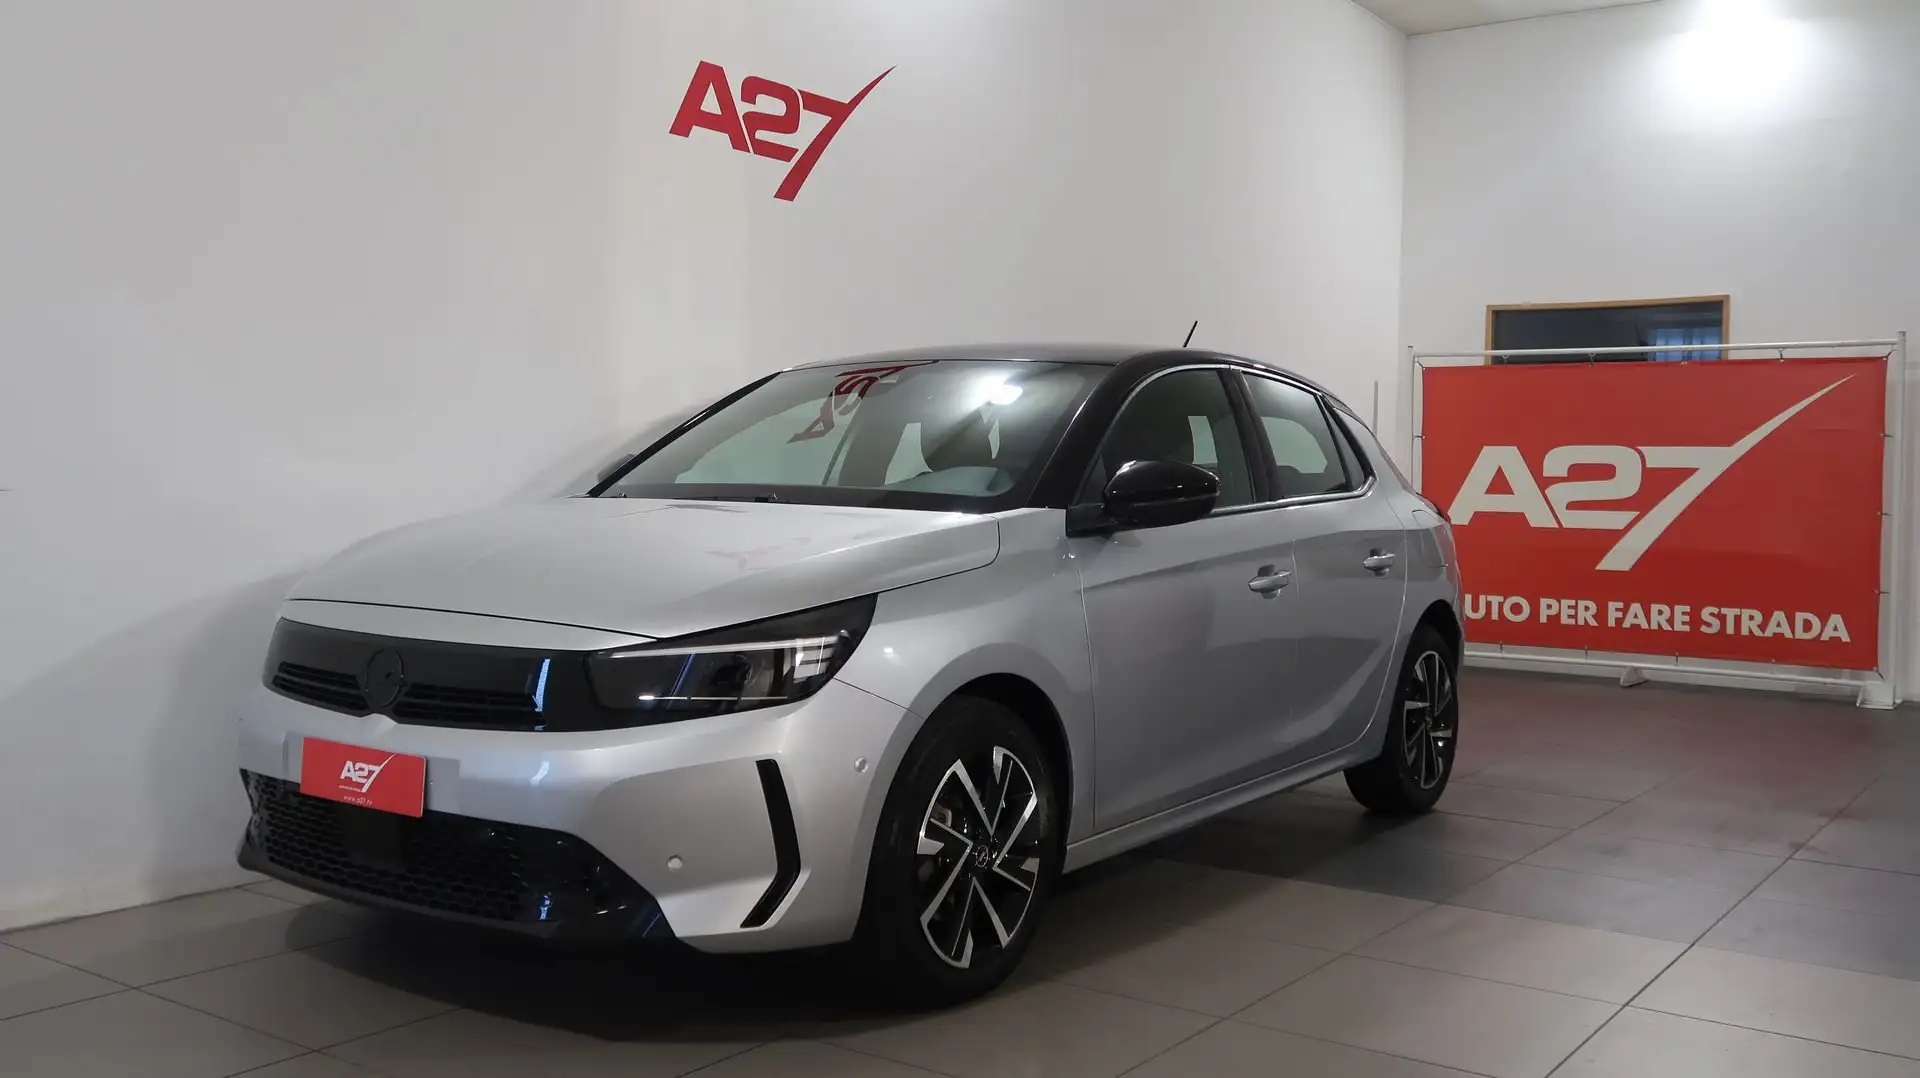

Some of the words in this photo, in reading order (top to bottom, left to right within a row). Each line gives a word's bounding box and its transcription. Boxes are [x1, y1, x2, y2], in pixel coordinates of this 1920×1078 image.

[669, 60, 897, 202] A27
[1447, 373, 1857, 571] A27
[1464, 594, 1530, 622] UTO
[1539, 597, 1599, 626] PER
[1607, 601, 1691, 632] FARE
[1700, 606, 1851, 642] STRADA
[340, 753, 397, 793] A27
